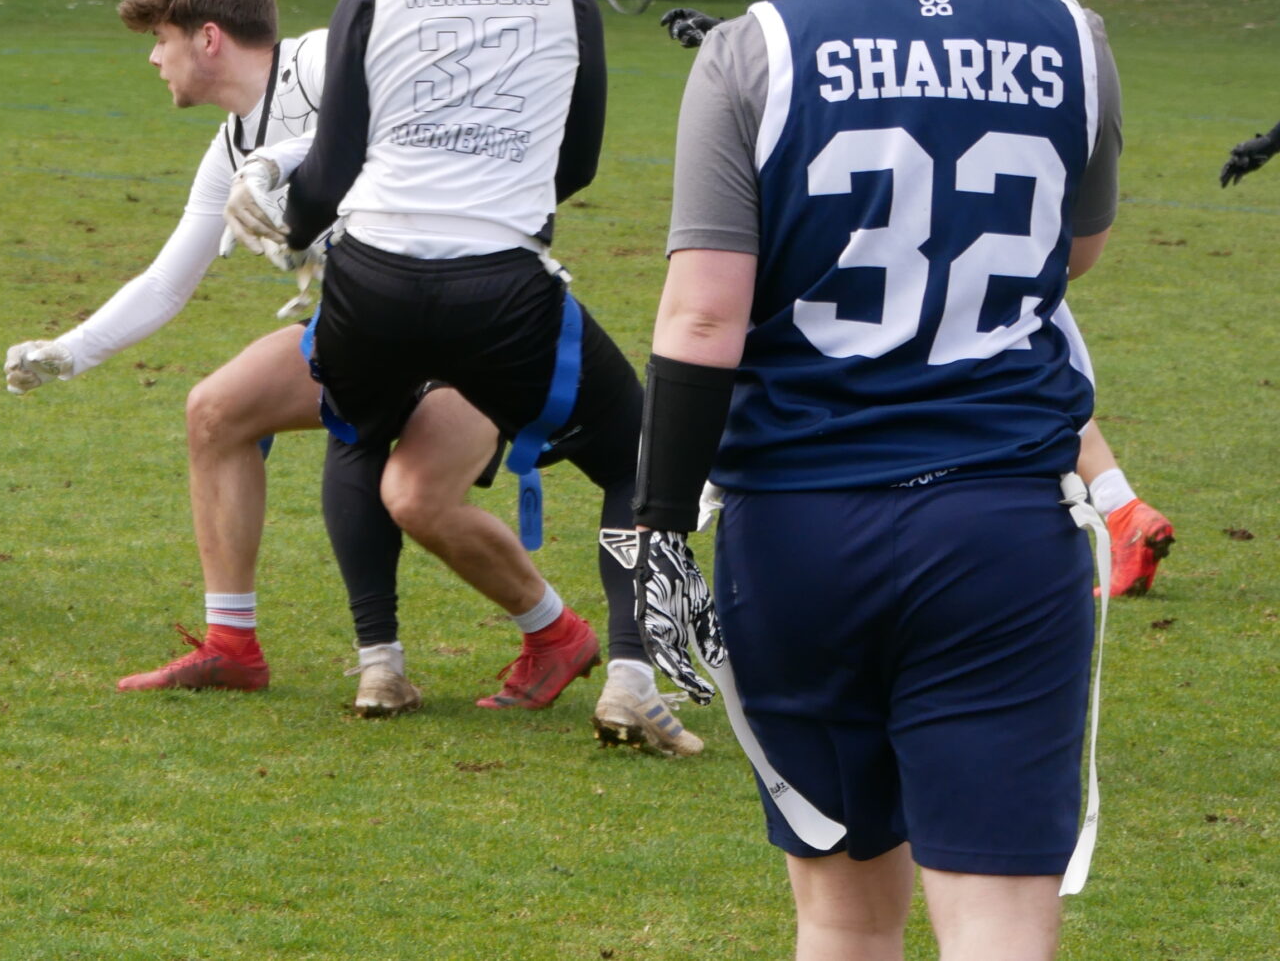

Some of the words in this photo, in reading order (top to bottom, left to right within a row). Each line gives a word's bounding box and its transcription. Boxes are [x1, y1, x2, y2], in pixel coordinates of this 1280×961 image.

[413, 15, 537, 113] 32
[816, 37, 1065, 109] SHARKS
[391, 123, 532, 163] WOMBATS
[792, 126, 1067, 366] 32
